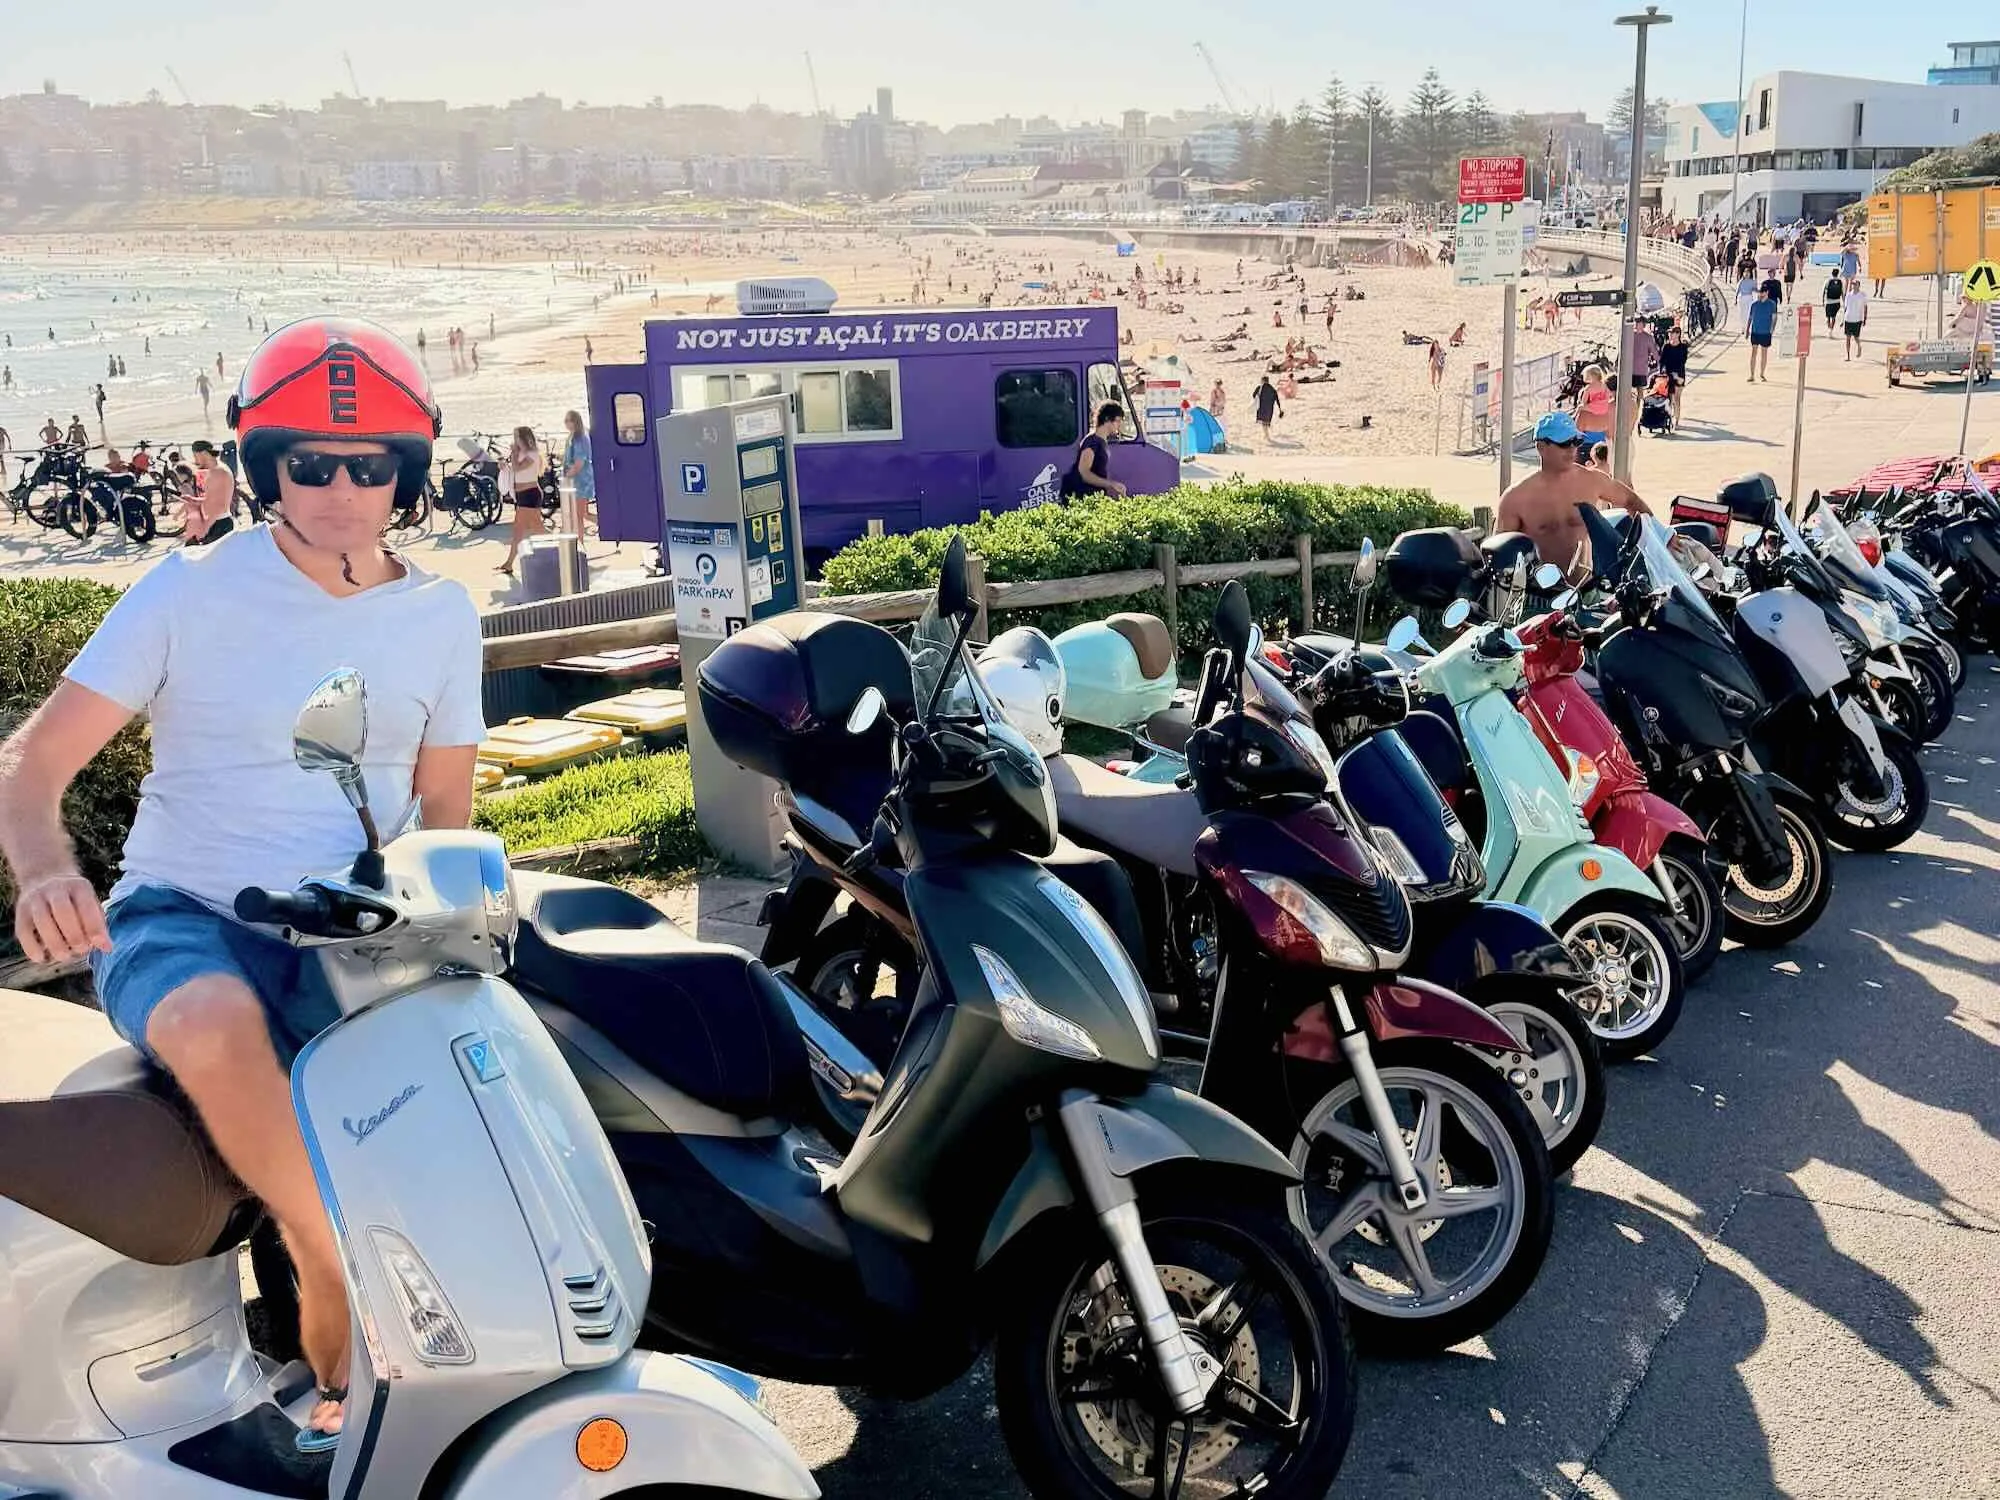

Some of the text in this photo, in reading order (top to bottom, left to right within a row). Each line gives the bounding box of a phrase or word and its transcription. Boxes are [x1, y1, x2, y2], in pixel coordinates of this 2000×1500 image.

[1466, 159, 1519, 172] NO STOPPING
[1461, 203, 1488, 223] 2P
[1501, 202, 1514, 223] P
[676, 318, 1091, 351] NOT JUST AÇAÍ, IT'S OAKBERRY
[1028, 483, 1053, 498] OAK
[342, 1084, 424, 1146] Vespa
